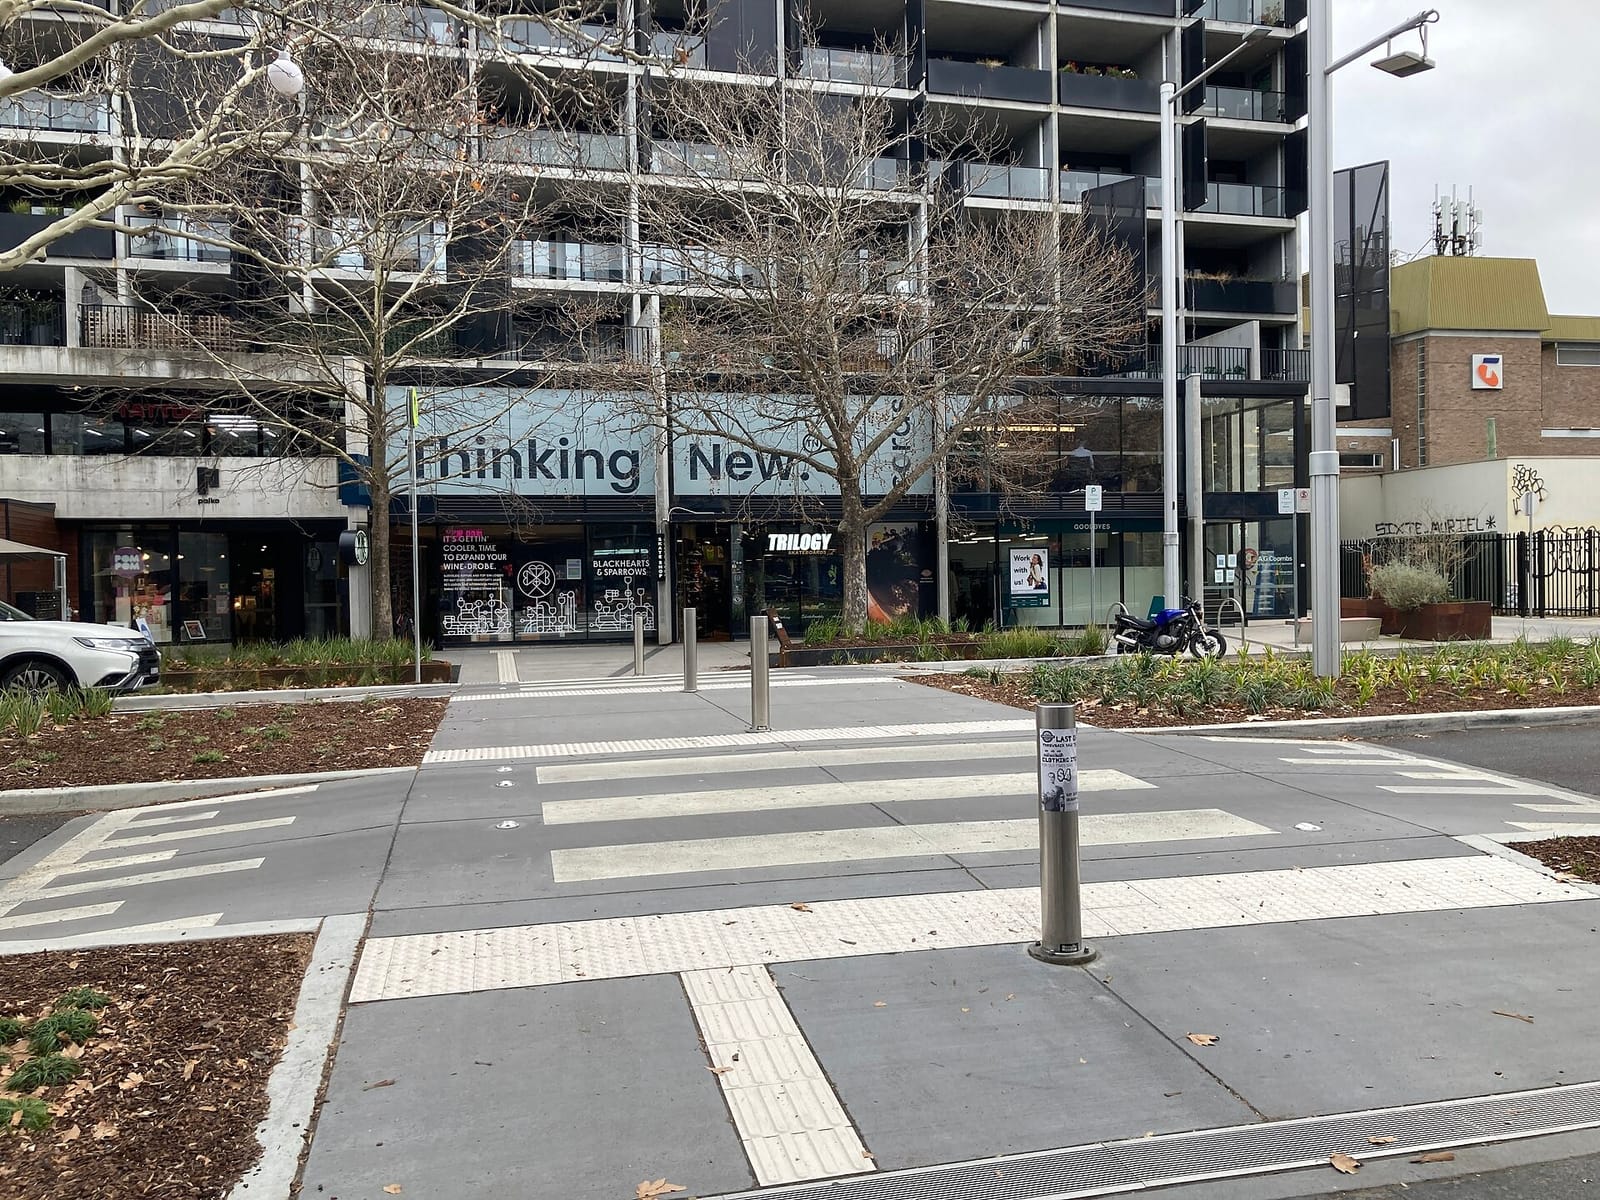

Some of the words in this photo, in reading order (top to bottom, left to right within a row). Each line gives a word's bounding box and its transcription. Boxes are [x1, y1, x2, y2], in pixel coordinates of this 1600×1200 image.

[405, 436, 641, 493] Thinking
[768, 533, 832, 551] TRILOGY
[604, 568, 647, 576] SPARROWS
